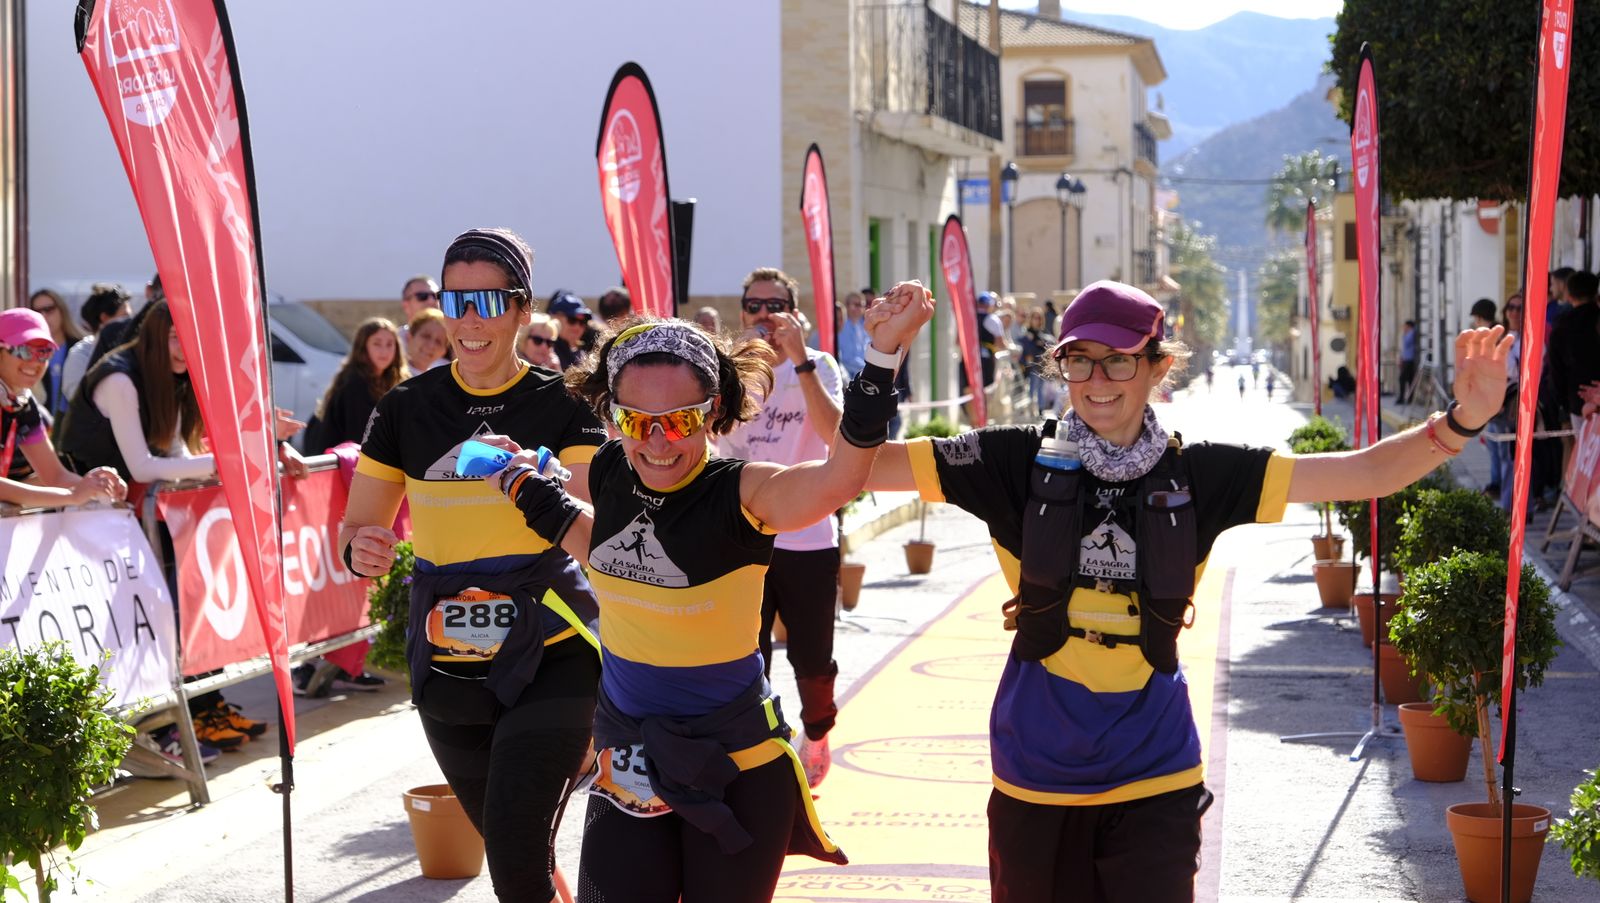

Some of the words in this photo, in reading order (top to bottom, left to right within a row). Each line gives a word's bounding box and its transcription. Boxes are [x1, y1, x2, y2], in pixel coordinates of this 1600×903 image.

[442, 470, 484, 480] SkyR
[104, 556, 139, 583] DE
[281, 522, 358, 596] EOL
[612, 558, 624, 566] LA
[625, 562, 656, 573] SAGRA
[1086, 557, 1098, 566] LA
[1100, 560, 1131, 569] SAGRA
[600, 562, 665, 584] SkyRace
[445, 603, 516, 628] 288
[1, 593, 156, 662] TORIA
